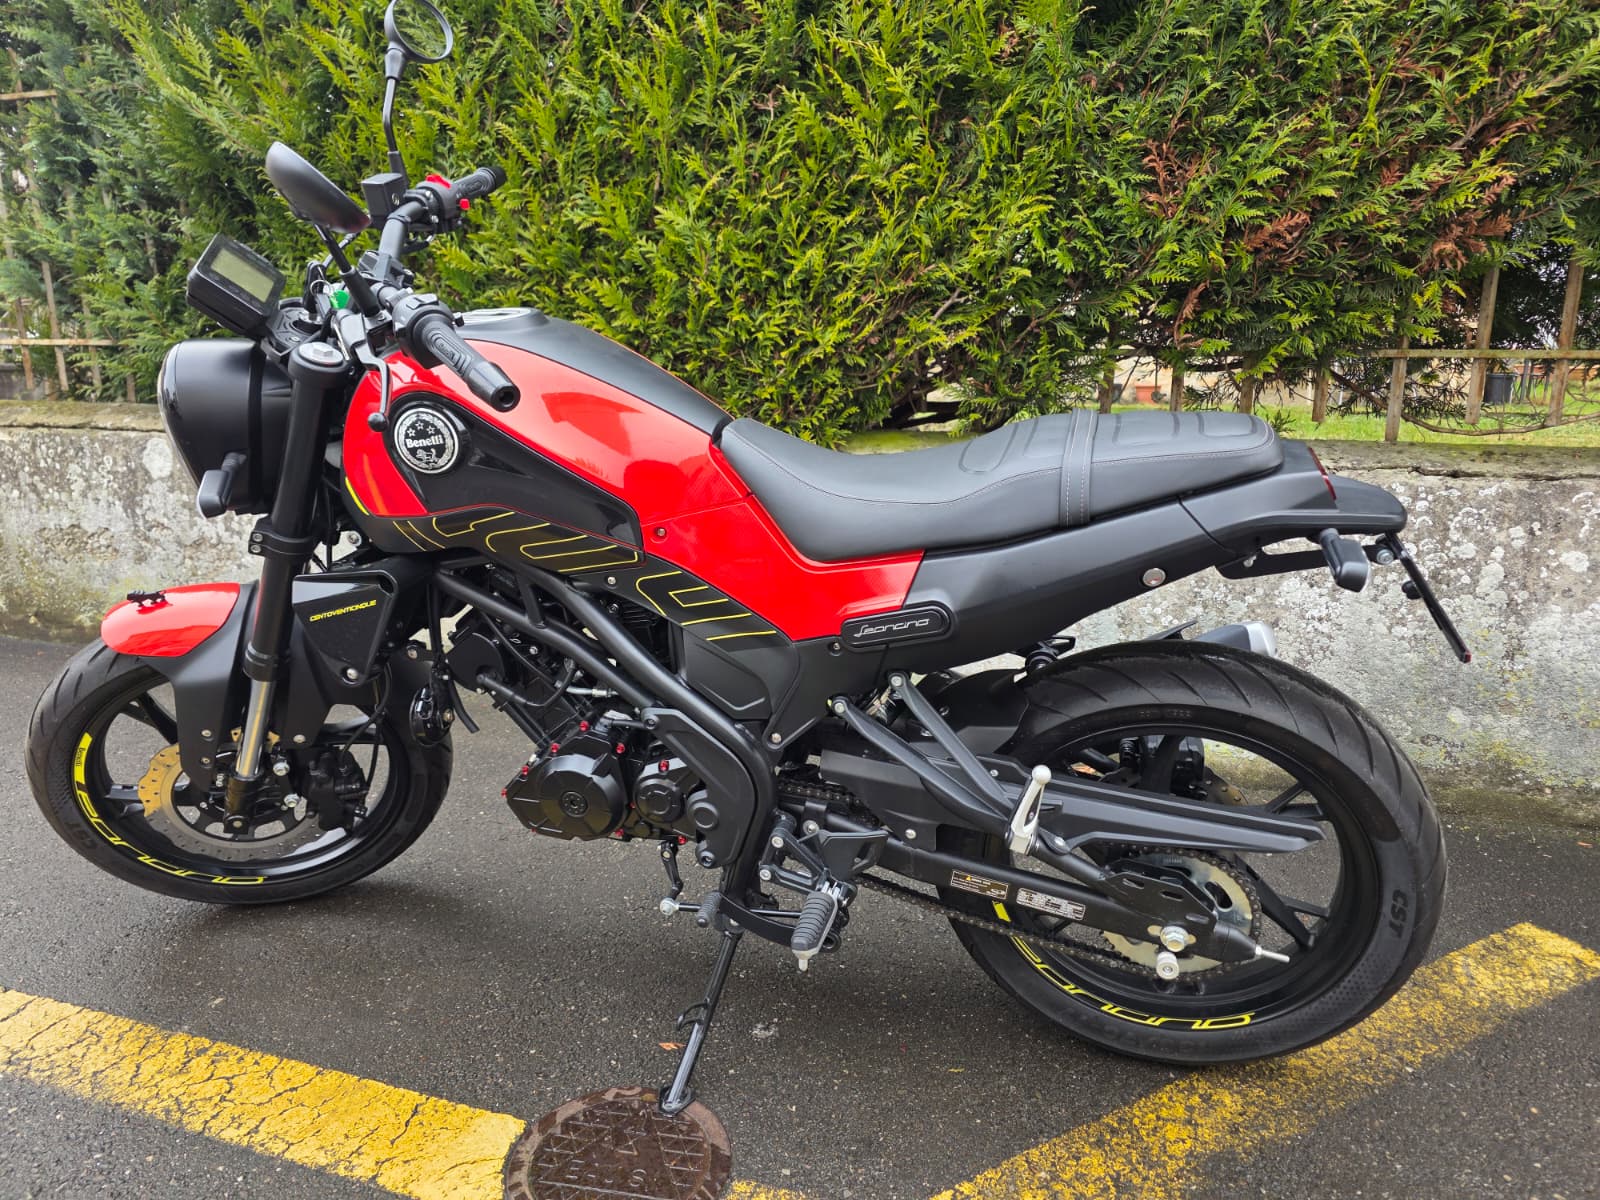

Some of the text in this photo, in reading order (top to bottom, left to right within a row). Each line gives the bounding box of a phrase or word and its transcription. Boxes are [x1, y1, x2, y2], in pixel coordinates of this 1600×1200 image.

[405, 434, 444, 449] Benelli
[853, 618, 930, 638] Leoncino
[1390, 889, 1408, 939] CST
